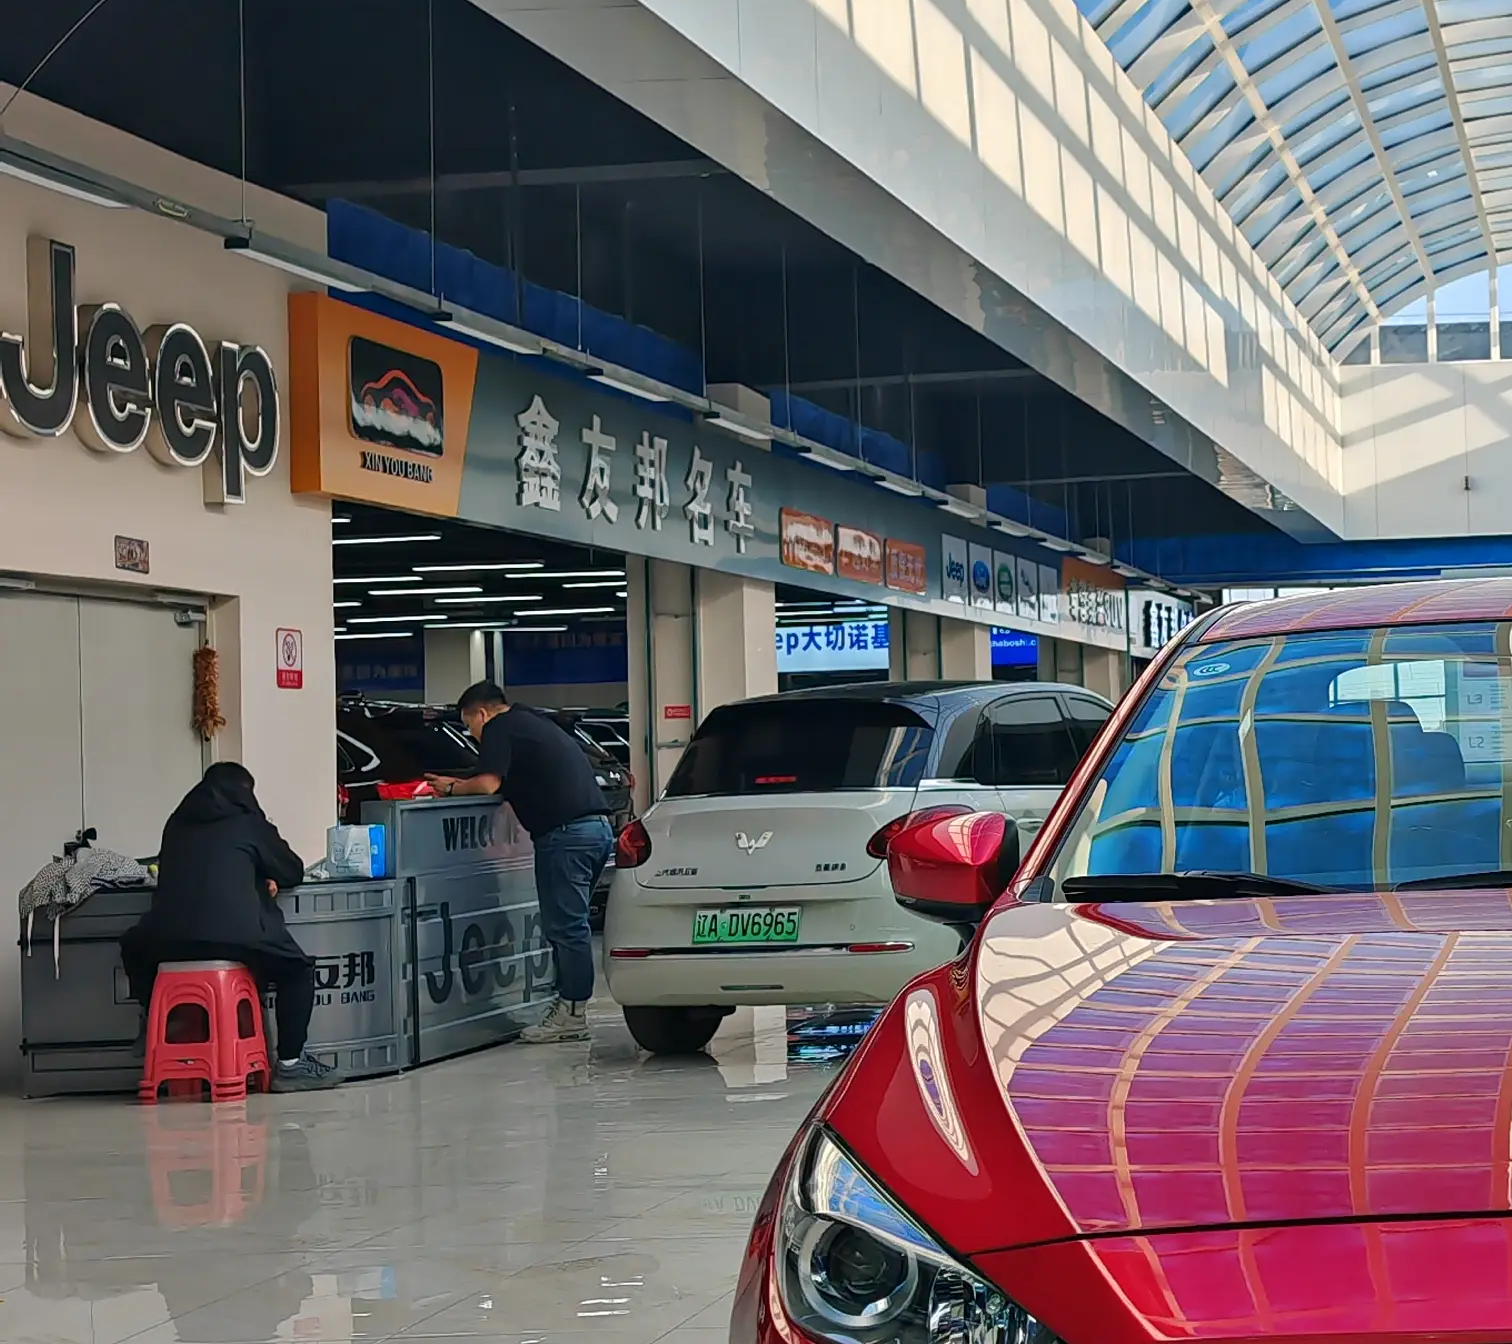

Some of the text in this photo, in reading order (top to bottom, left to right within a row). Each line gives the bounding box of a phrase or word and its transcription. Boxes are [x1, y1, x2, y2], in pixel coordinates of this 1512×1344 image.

[0, 237, 281, 505] Jeep
[361, 451, 383, 472] XIN
[384, 455, 406, 477] YOU
[515, 394, 756, 554] 鑫友邦名车
[1467, 693, 1483, 705] L3
[1468, 736, 1485, 749] L2
[728, 912, 798, 937] DV6965
[425, 901, 550, 1004] Jeep
[340, 990, 375, 1004] BANG
